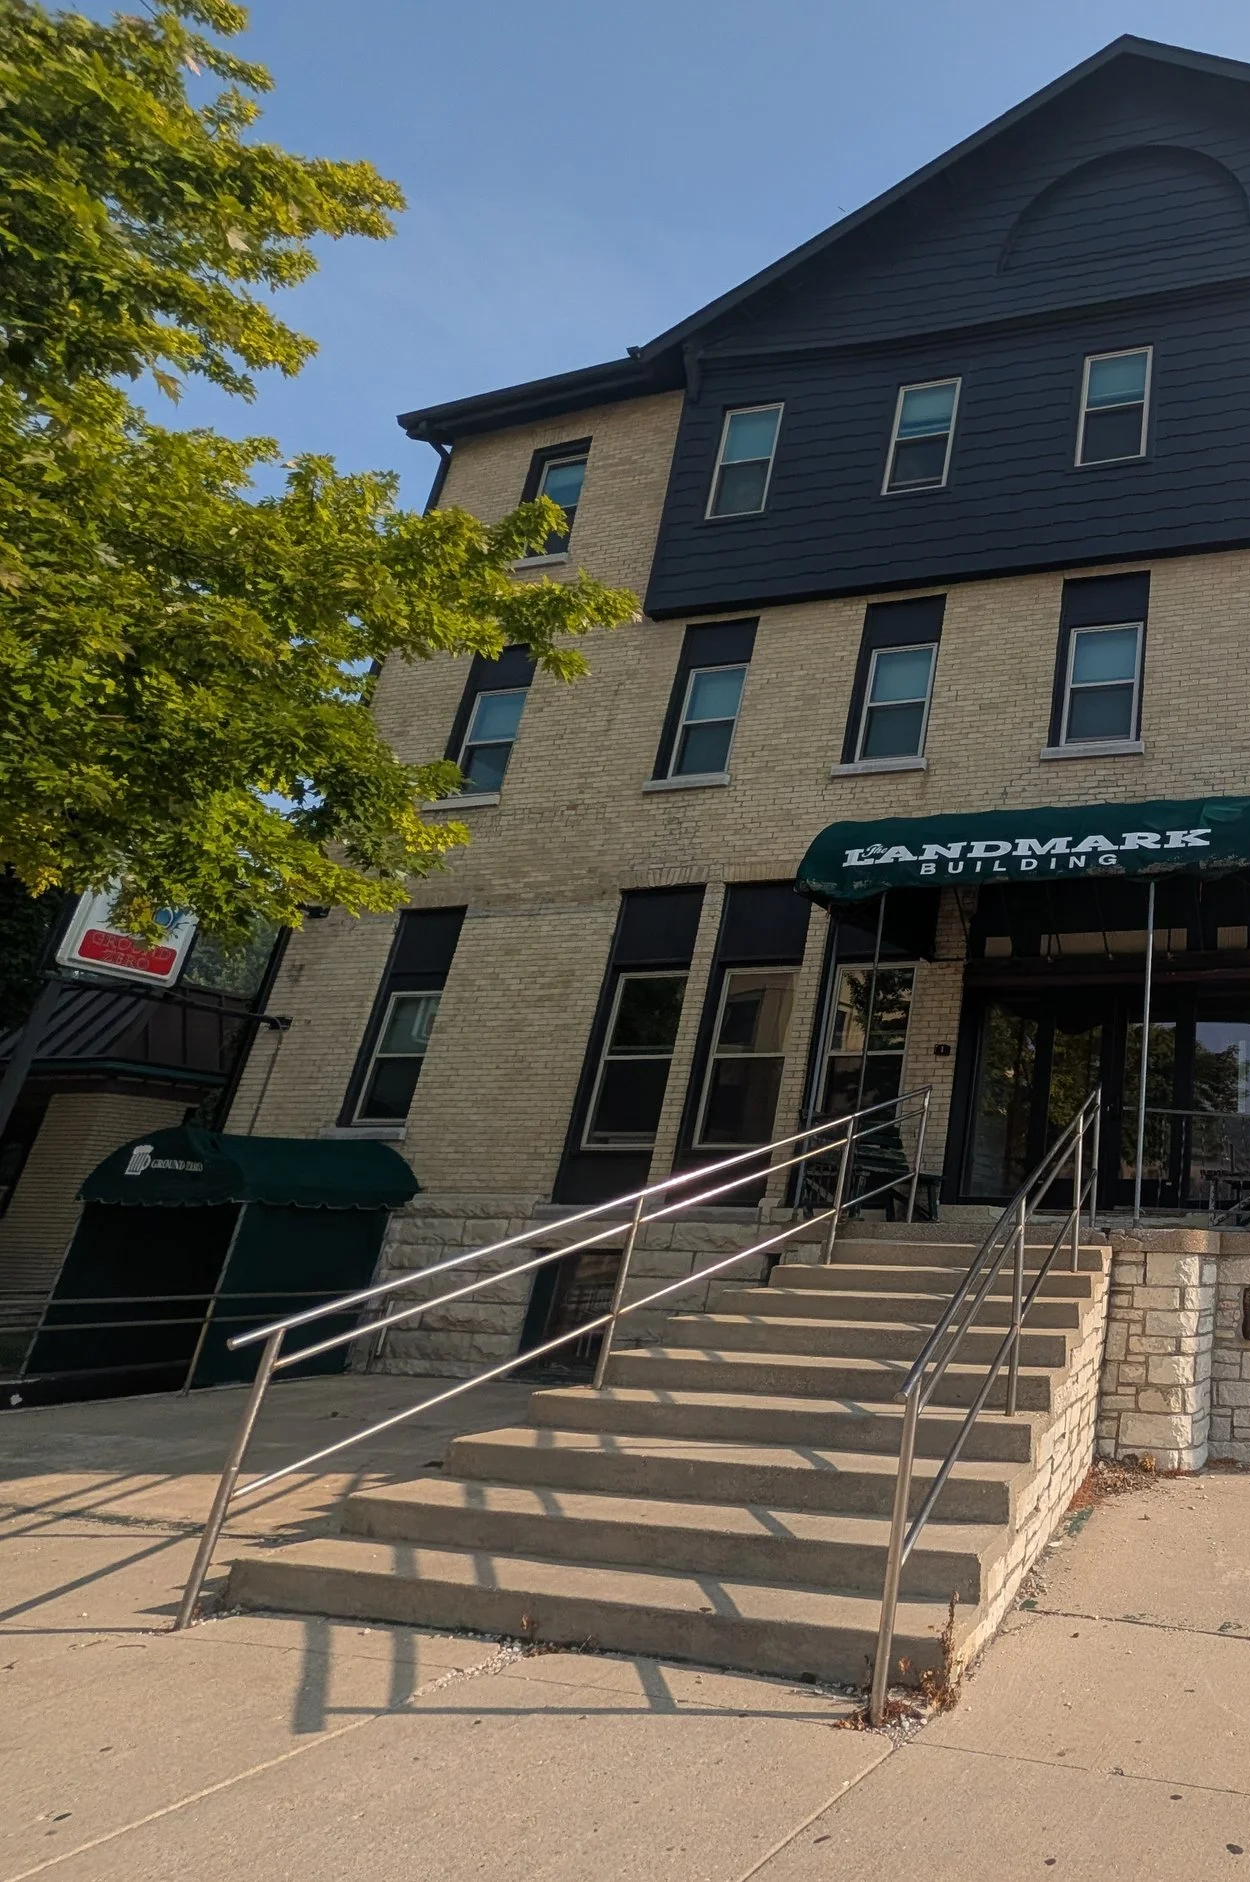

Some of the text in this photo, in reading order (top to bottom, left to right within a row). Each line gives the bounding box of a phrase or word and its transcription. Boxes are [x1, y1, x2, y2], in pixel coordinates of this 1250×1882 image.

[842, 829, 1212, 868] The LANDMARK
[920, 854, 1118, 876] BUILDING
[92, 933, 171, 961] GROD
[103, 950, 150, 970] ZERO
[151, 1159, 185, 1171] GROUND
